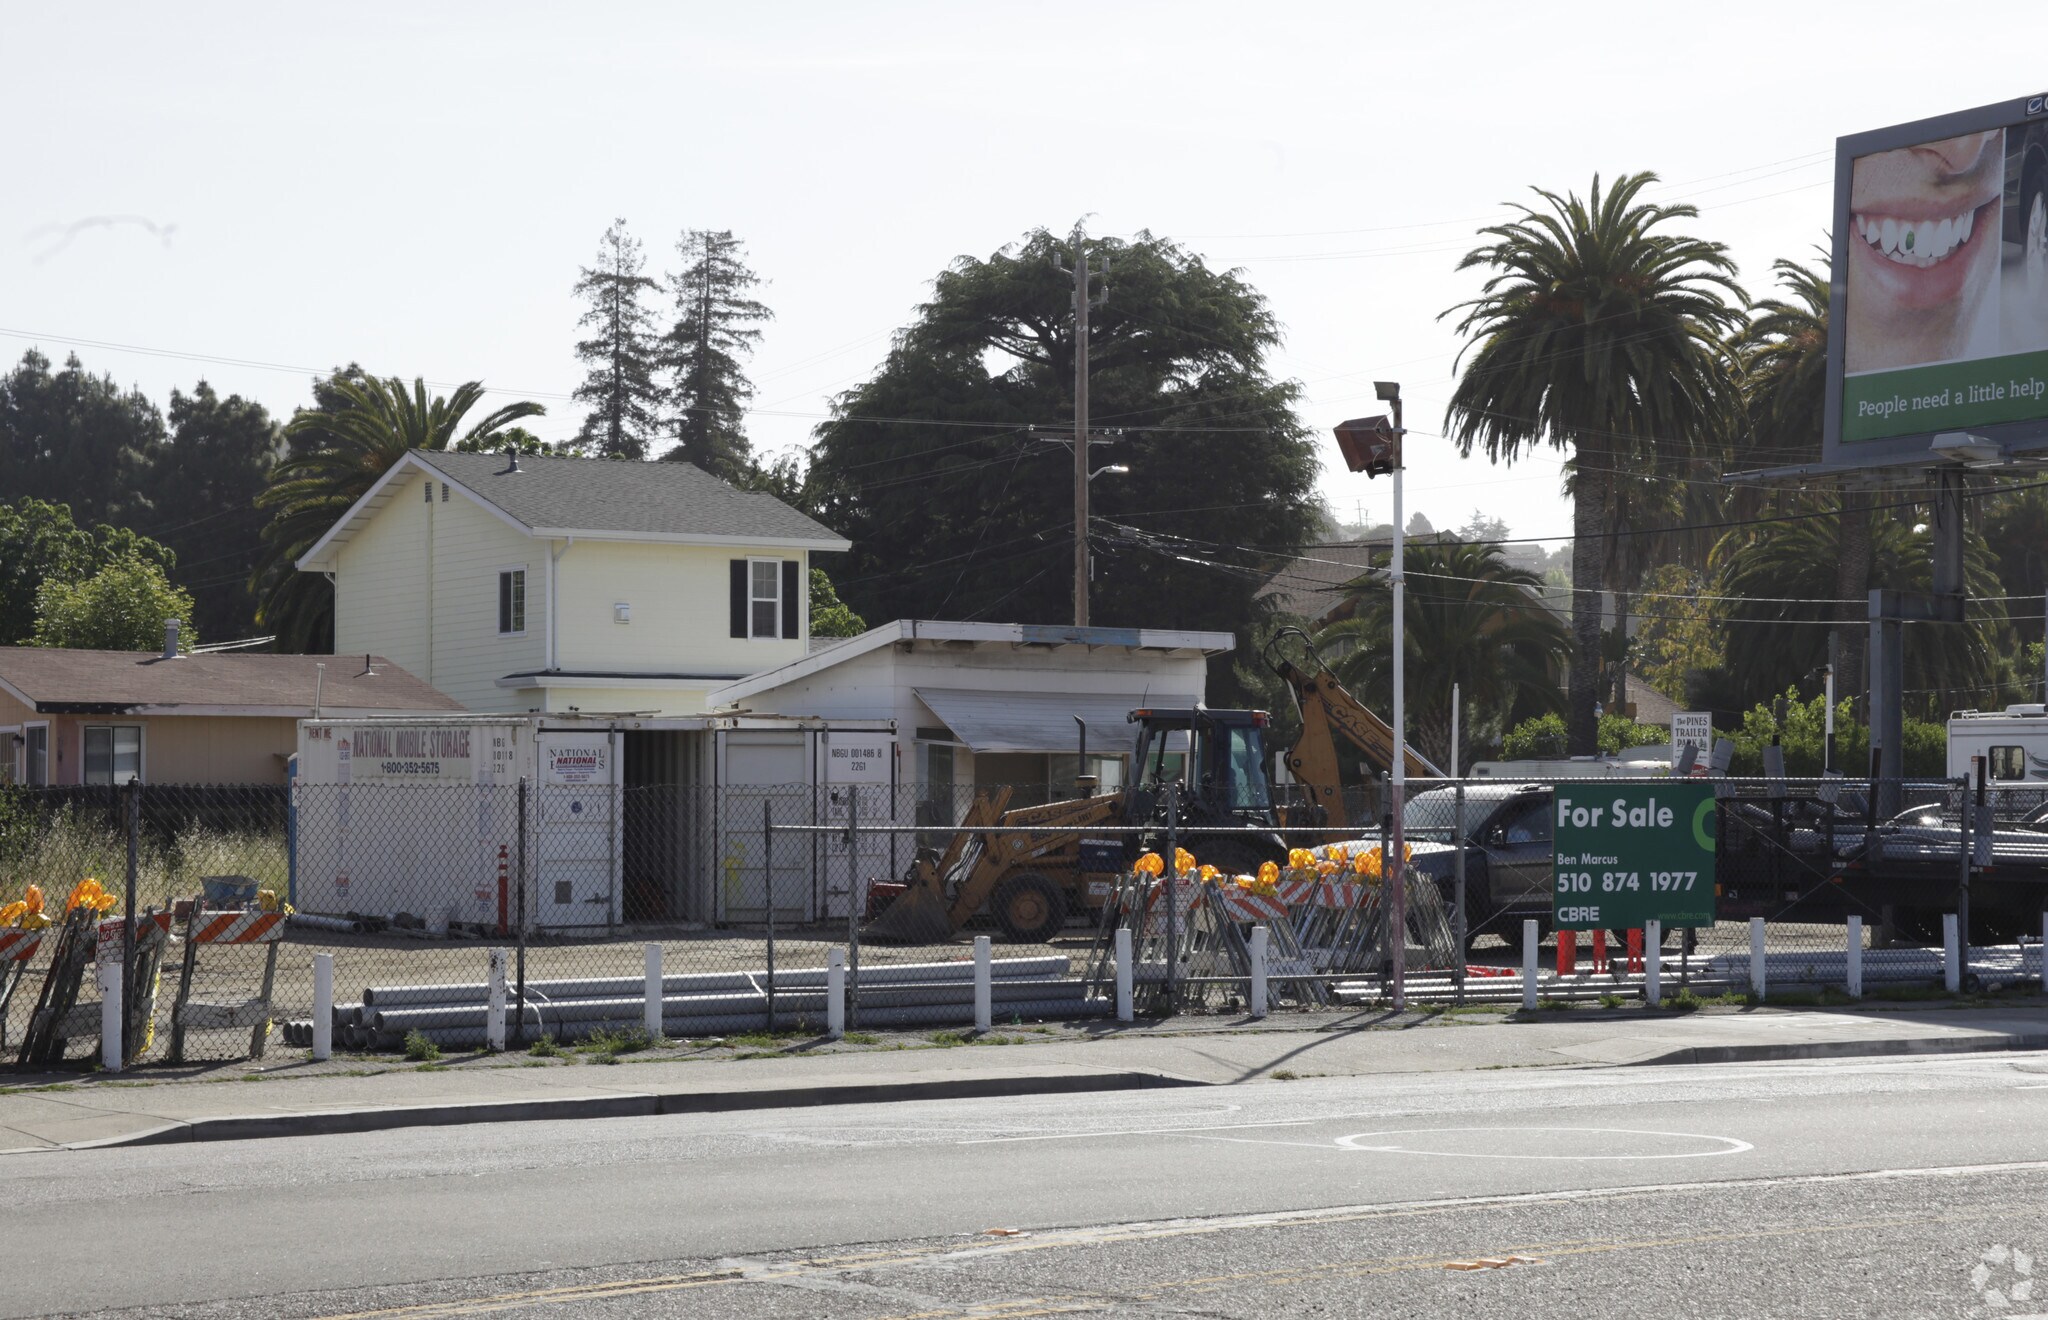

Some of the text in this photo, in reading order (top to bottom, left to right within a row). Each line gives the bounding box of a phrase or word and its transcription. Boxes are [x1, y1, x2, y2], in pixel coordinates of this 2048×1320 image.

[1858, 378, 2045, 418] People need a little help
[1332, 705, 1379, 743] CASE
[1676, 716, 1708, 726] The PINES
[1675, 727, 1708, 737] TRAILER
[352, 729, 471, 758] NATIONAL MOBILE STORAGE
[550, 748, 605, 759] NATIONAL
[850, 748, 875, 758] 001486
[877, 748, 882, 758] 8
[556, 756, 597, 765] NATIONAL
[381, 761, 440, 775] 1-800-352-5675
[1028, 807, 1072, 823] CASE
[1557, 797, 1674, 828] For Sale
[1557, 853, 1618, 865] Ben Marcus
[1557, 871, 1698, 893] 510 874 1977
[1557, 906, 1600, 922] CBRE
[1657, 911, 1711, 921] www.cbre.com
